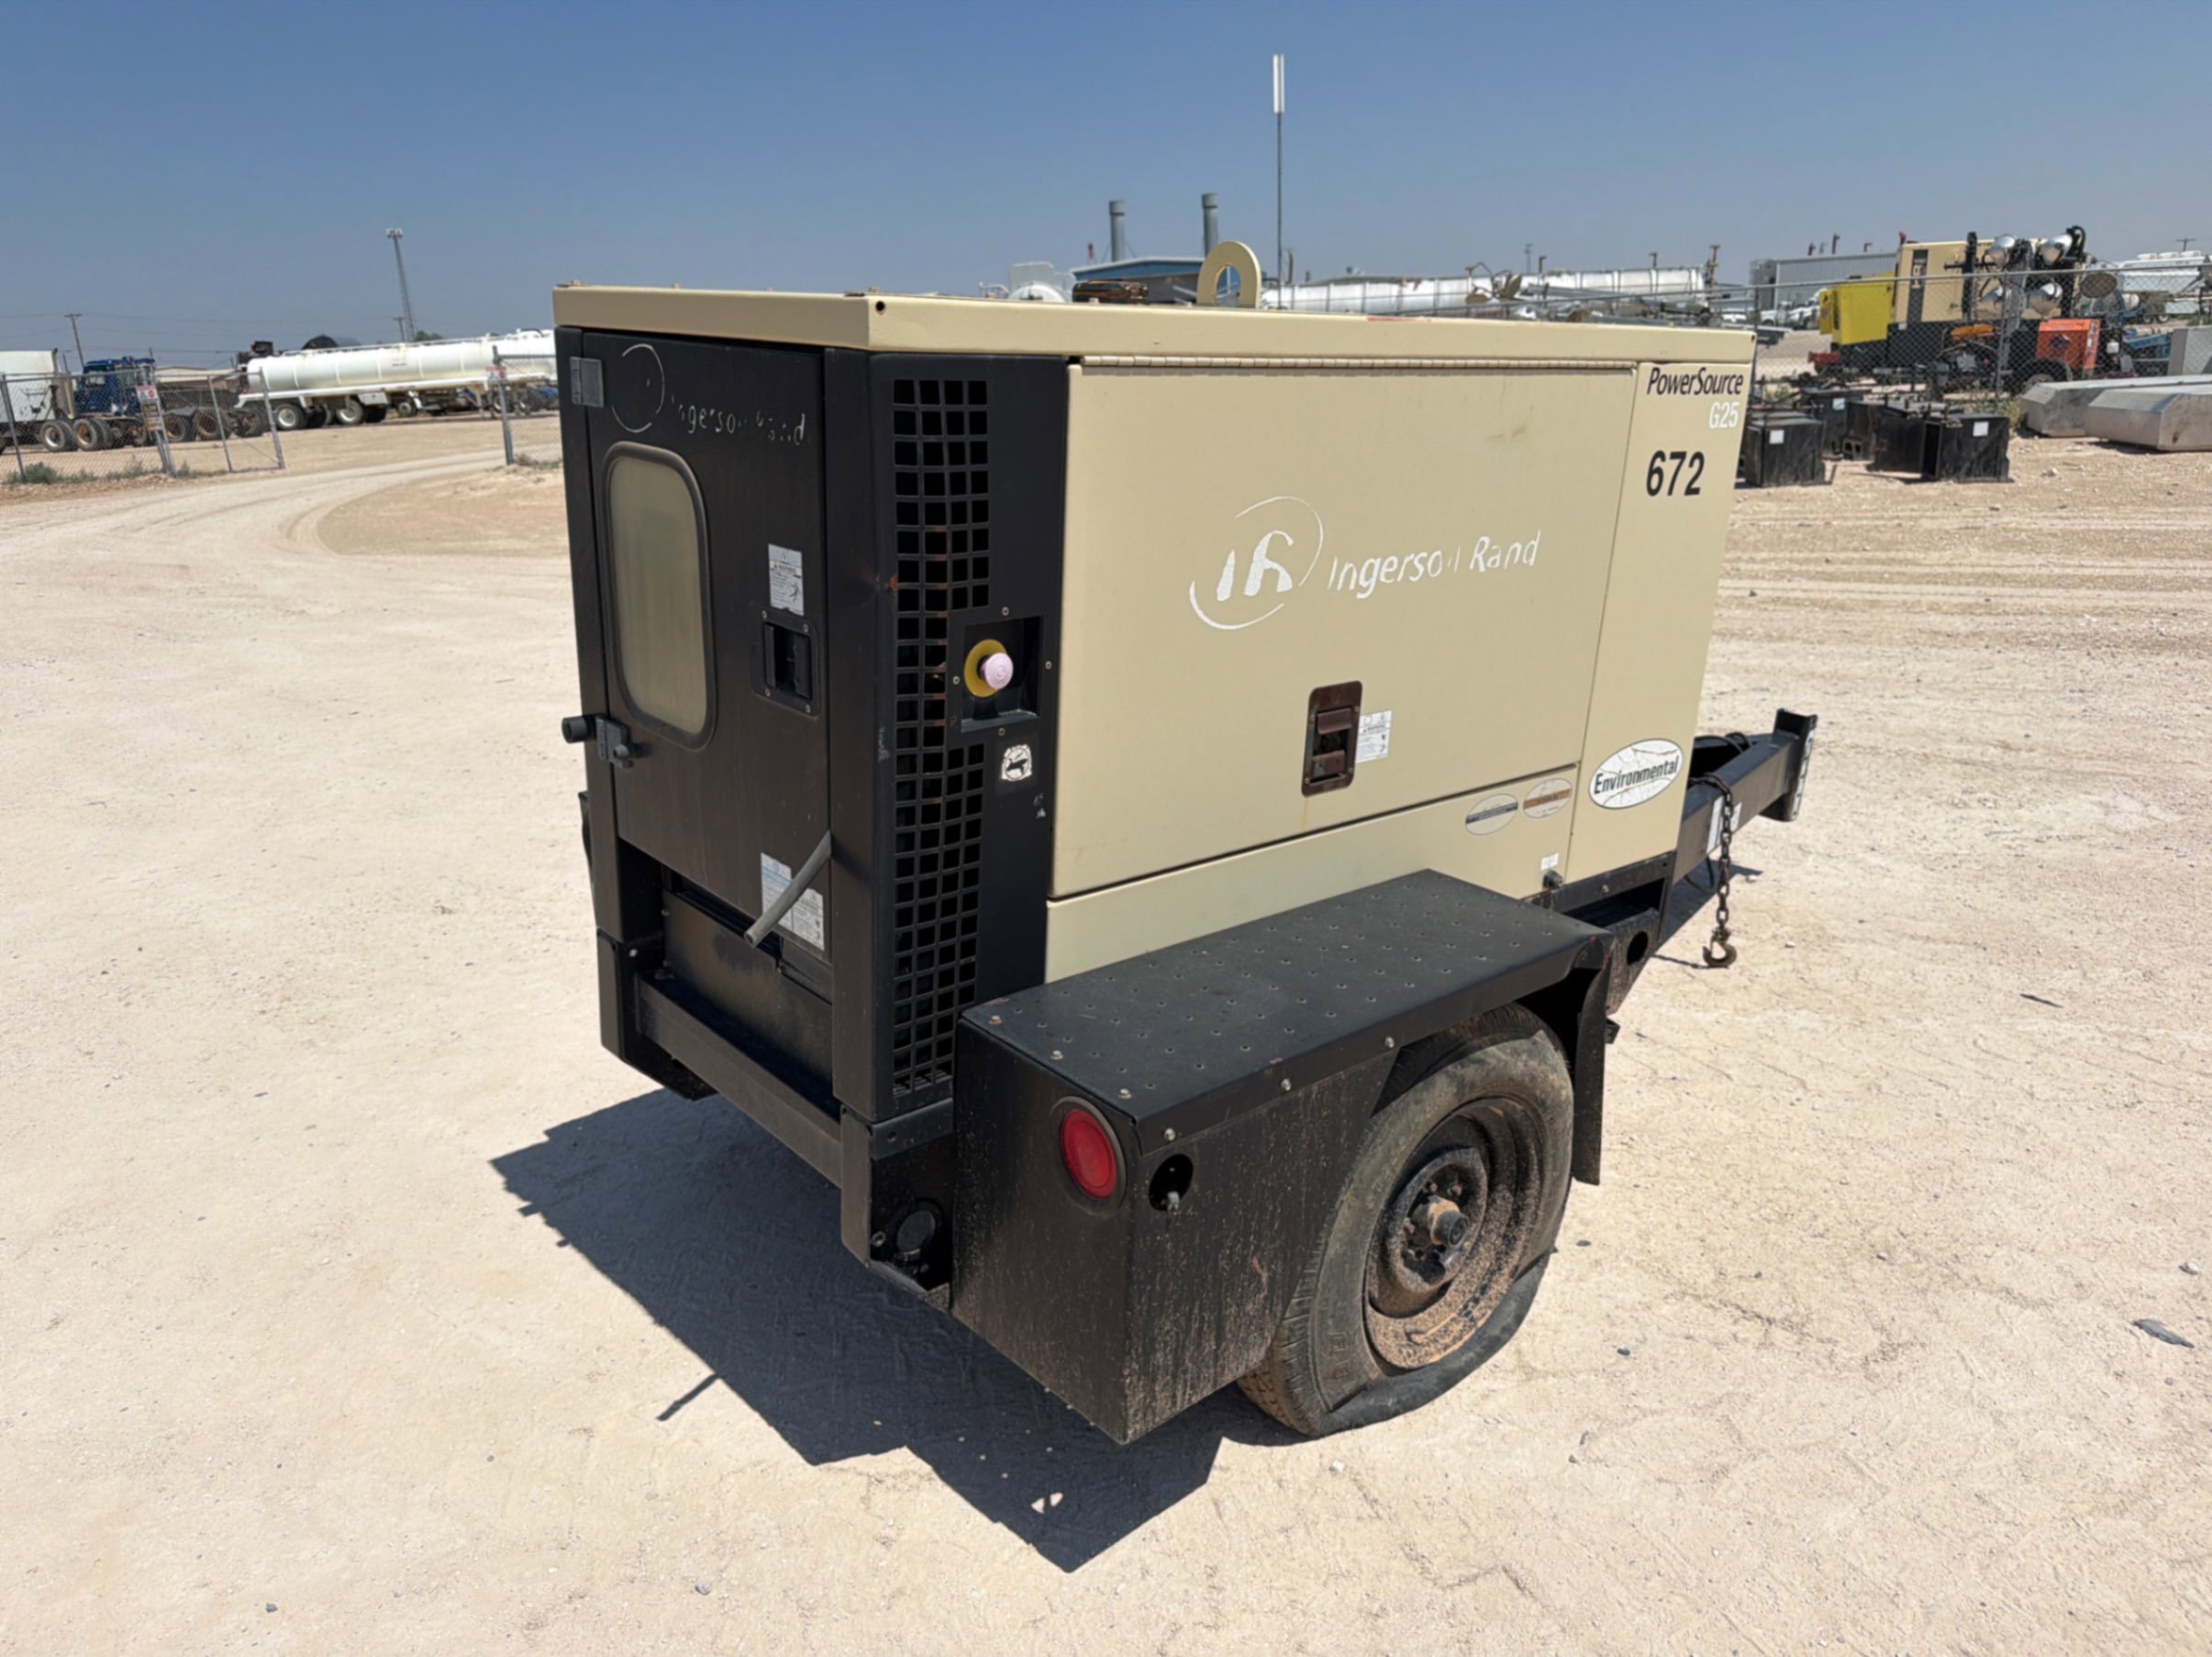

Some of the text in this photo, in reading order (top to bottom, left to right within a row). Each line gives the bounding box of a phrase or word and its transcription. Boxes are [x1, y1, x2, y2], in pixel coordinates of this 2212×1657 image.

[1647, 366, 1744, 395] PowerSource
[1709, 401, 1740, 428] G25
[1646, 450, 1705, 496] 672
[1470, 529, 1541, 573] Rand
[1594, 754, 1680, 795] Environmental
